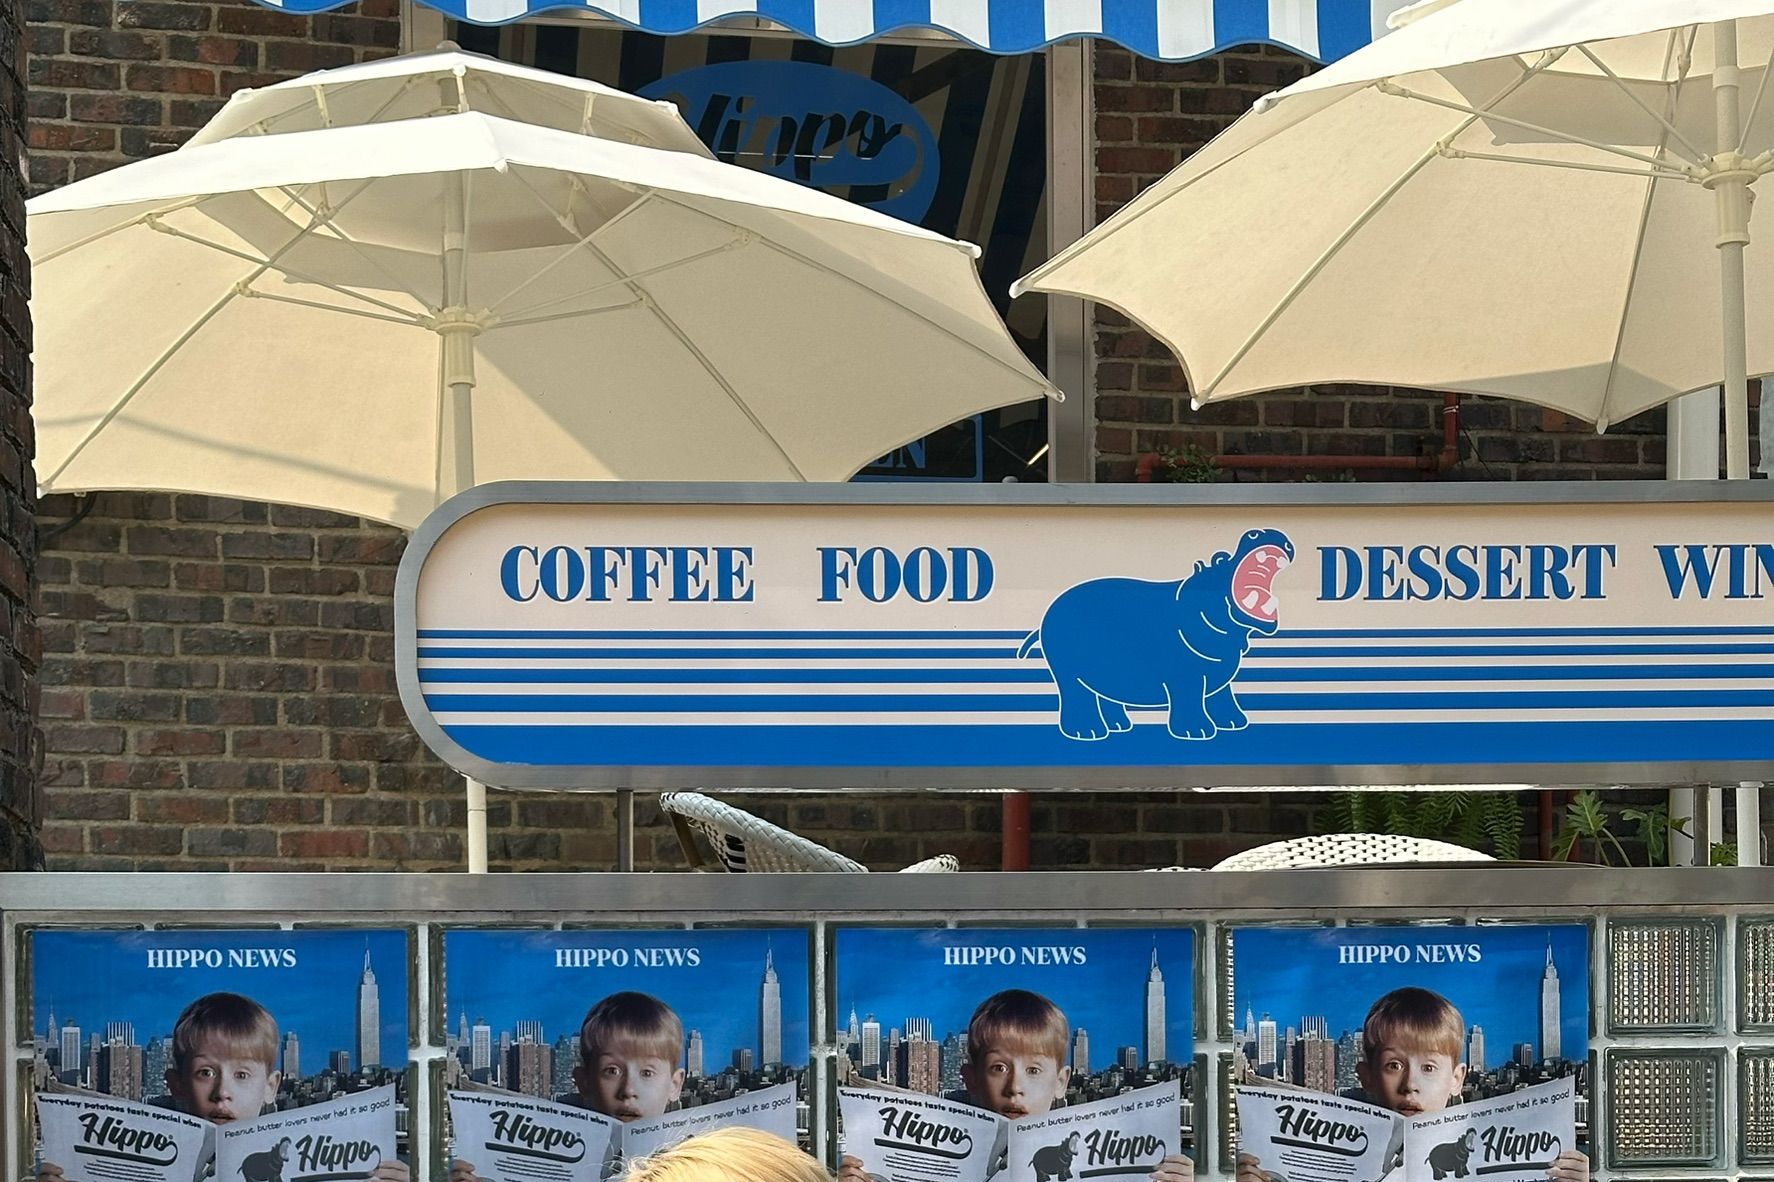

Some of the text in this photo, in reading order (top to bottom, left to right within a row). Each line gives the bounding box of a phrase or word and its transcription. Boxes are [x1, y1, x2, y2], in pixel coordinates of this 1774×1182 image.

[499, 545, 756, 603] COFFEE
[816, 545, 995, 603] FOOD
[1316, 544, 1617, 602] DESSERT
[146, 947, 297, 969] HIPPO NEWS
[554, 947, 701, 968] HIPPO NEWS
[943, 945, 1087, 966] HIPPO NEWS
[1338, 943, 1482, 964] HIPPO NEWS
[224, 1127, 255, 1138] Peanut
[258, 1121, 284, 1132] butter
[286, 1117, 308, 1127] lovers
[311, 1113, 332, 1122] never
[334, 1107, 347, 1118] had
[350, 1106, 356, 1114] it
[370, 1097, 389, 1111] good
[631, 1094, 790, 1136] Peanut butter lovers never had it so good
[878, 1107, 972, 1148] Hippo
[1017, 1121, 1045, 1132] Peanut
[1048, 1116, 1073, 1126] butter
[1075, 1112, 1097, 1122] lovers
[1099, 1108, 1119, 1117] never
[1121, 1102, 1134, 1113] had
[1137, 1101, 1143, 1109] it
[1155, 1092, 1174, 1106] good
[1275, 1104, 1368, 1146] Hippo
[1413, 1089, 1570, 1130] Peanut butter lovers never had it so good
[79, 1113, 178, 1155] Hippo
[490, 1110, 585, 1152] Hippo
[1085, 1129, 1165, 1165] Hippo
[1481, 1125, 1561, 1162] Hippo
[296, 1134, 380, 1172] Hippo
